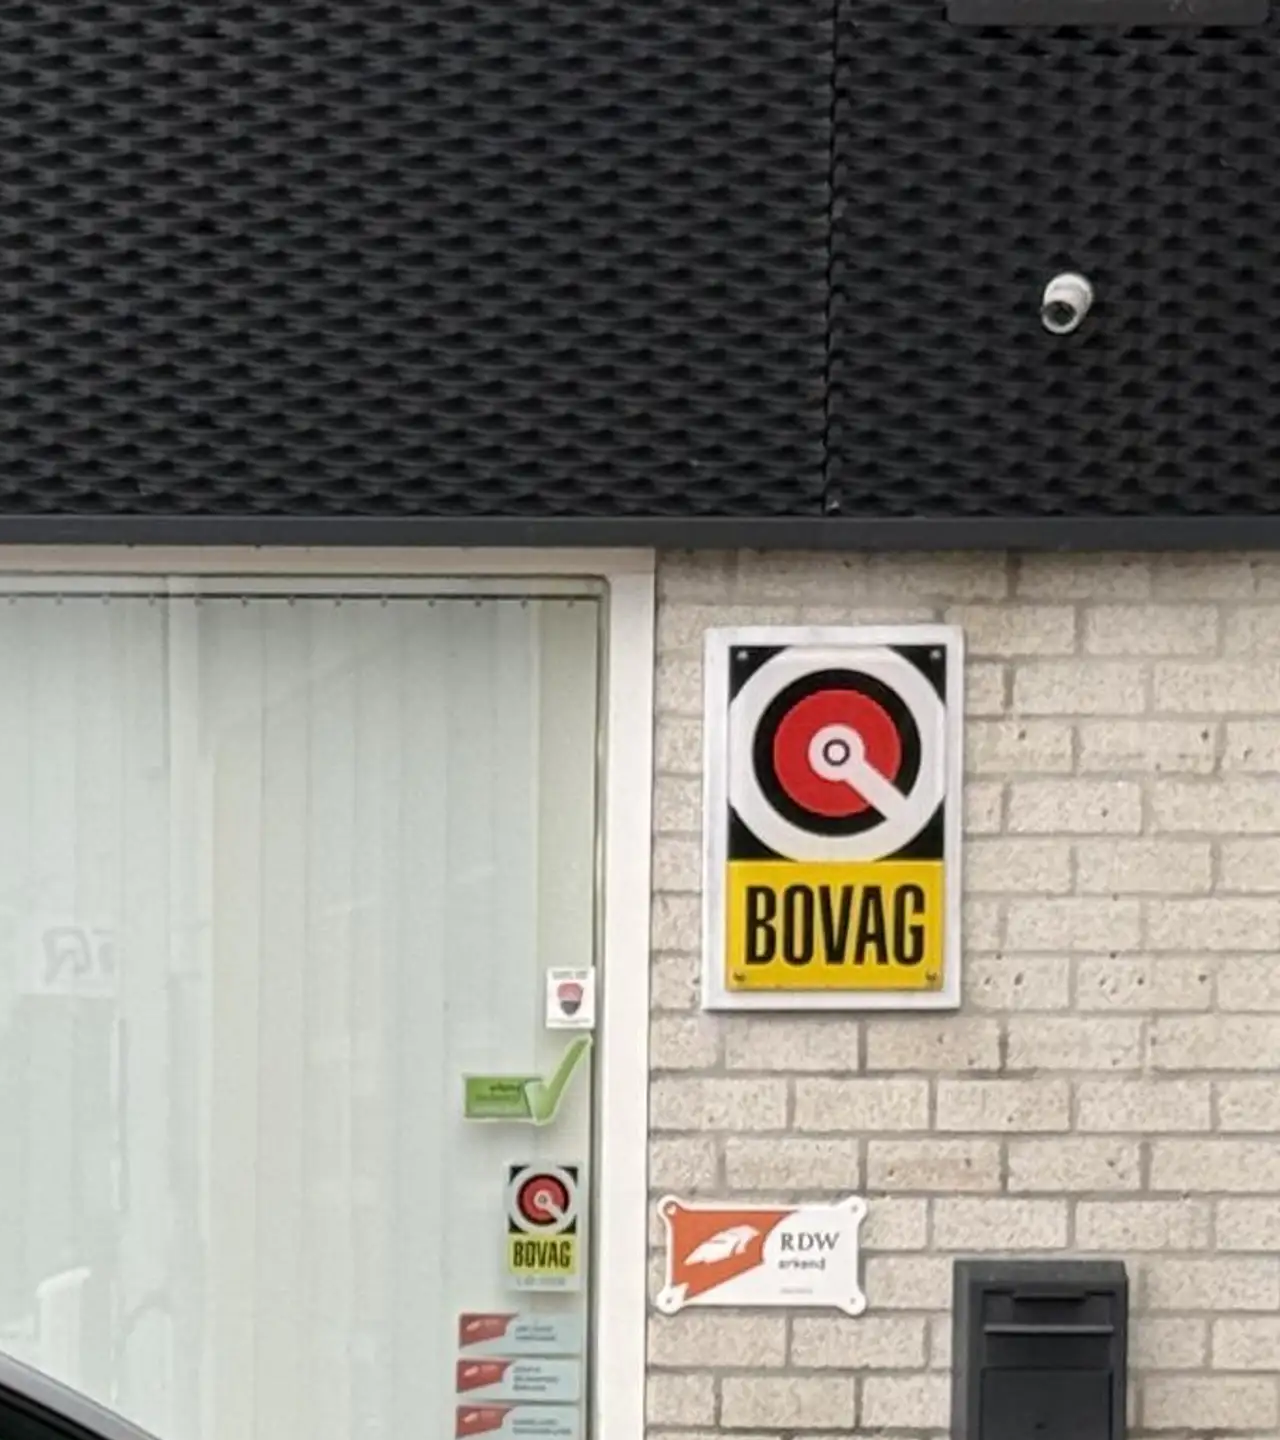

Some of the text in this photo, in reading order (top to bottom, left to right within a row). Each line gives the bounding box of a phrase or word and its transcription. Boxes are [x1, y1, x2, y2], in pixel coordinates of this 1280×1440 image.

[744, 882, 927, 967] BOVAG
[512, 1240, 572, 1269] BOVAG
[780, 1231, 841, 1252] RDW
